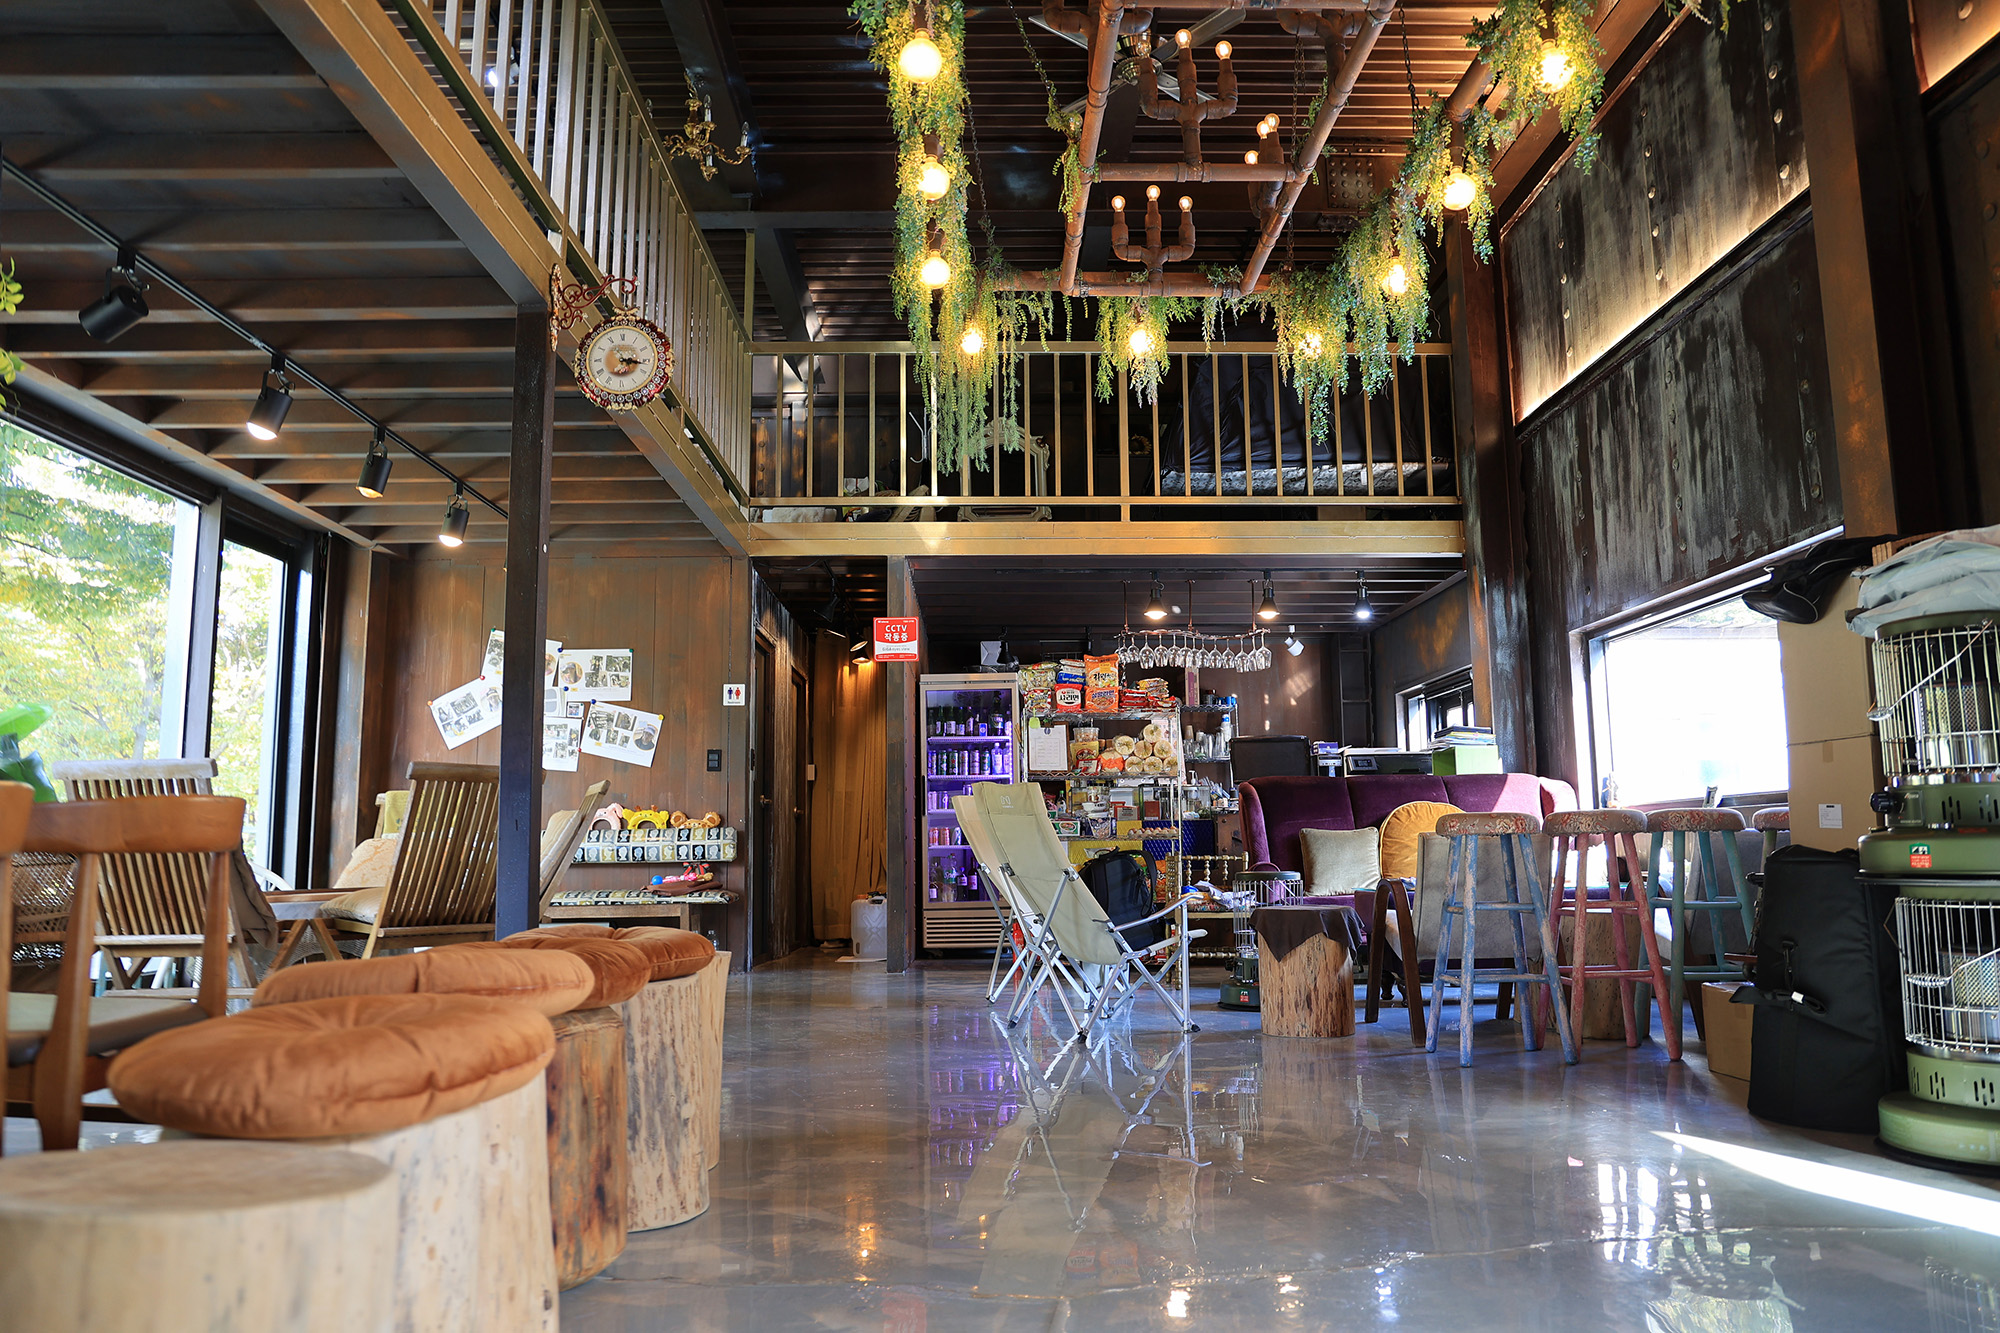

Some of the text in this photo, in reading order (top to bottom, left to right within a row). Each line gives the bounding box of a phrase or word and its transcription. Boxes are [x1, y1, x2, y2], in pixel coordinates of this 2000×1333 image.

[885, 624, 907, 632] CCTV
[884, 632, 909, 642] 작동중
[1059, 694, 1080, 702] 사리면
